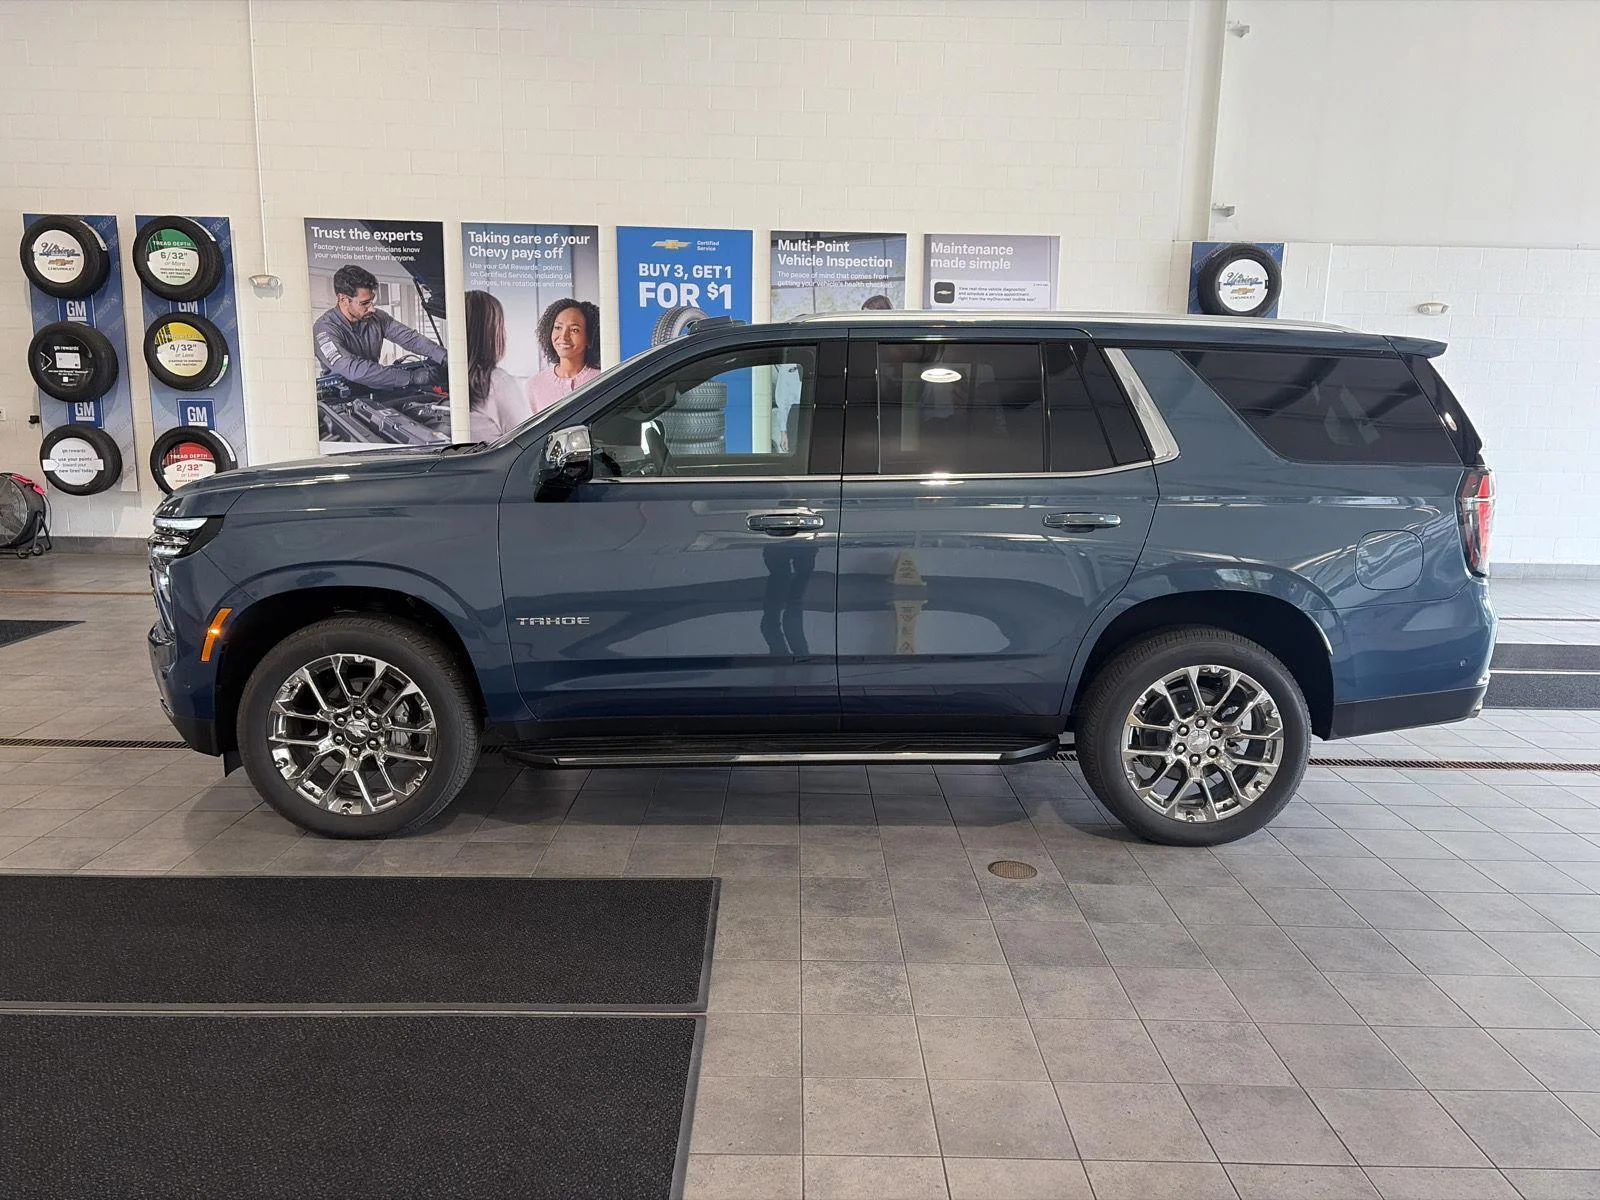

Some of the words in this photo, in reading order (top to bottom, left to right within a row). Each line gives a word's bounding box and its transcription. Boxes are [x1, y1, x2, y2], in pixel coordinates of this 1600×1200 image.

[310, 226, 346, 239] Trust
[349, 228, 370, 240] the
[373, 230, 424, 243] experts
[468, 231, 510, 245] Taking
[513, 234, 541, 244] care
[544, 233, 558, 244] of
[561, 235, 590, 246] your
[313, 243, 364, 252] Factory-trained
[365, 245, 401, 253] technicians
[777, 239, 850, 252] Multi-Point
[931, 242, 1014, 255] Maintenance
[353, 253, 373, 261] better
[469, 246, 508, 260] Chevy
[511, 249, 541, 261] pays
[544, 247, 563, 259] off
[777, 254, 823, 266] Vehicle
[826, 255, 893, 268] Inspection
[930, 257, 966, 269] made
[968, 258, 1011, 271] simple
[638, 263, 670, 277] BUY
[673, 264, 688, 280] 3,
[692, 265, 722, 278] GET
[725, 266, 732, 279] 1
[639, 281, 700, 308] FOR
[707, 281, 732, 309] $1
[66, 301, 86, 316] GM
[178, 301, 198, 313] GM
[169, 343, 197, 353] 4/32"
[75, 402, 94, 416] GM
[187, 406, 207, 422] GM
[515, 616, 590, 626] TAHOE
